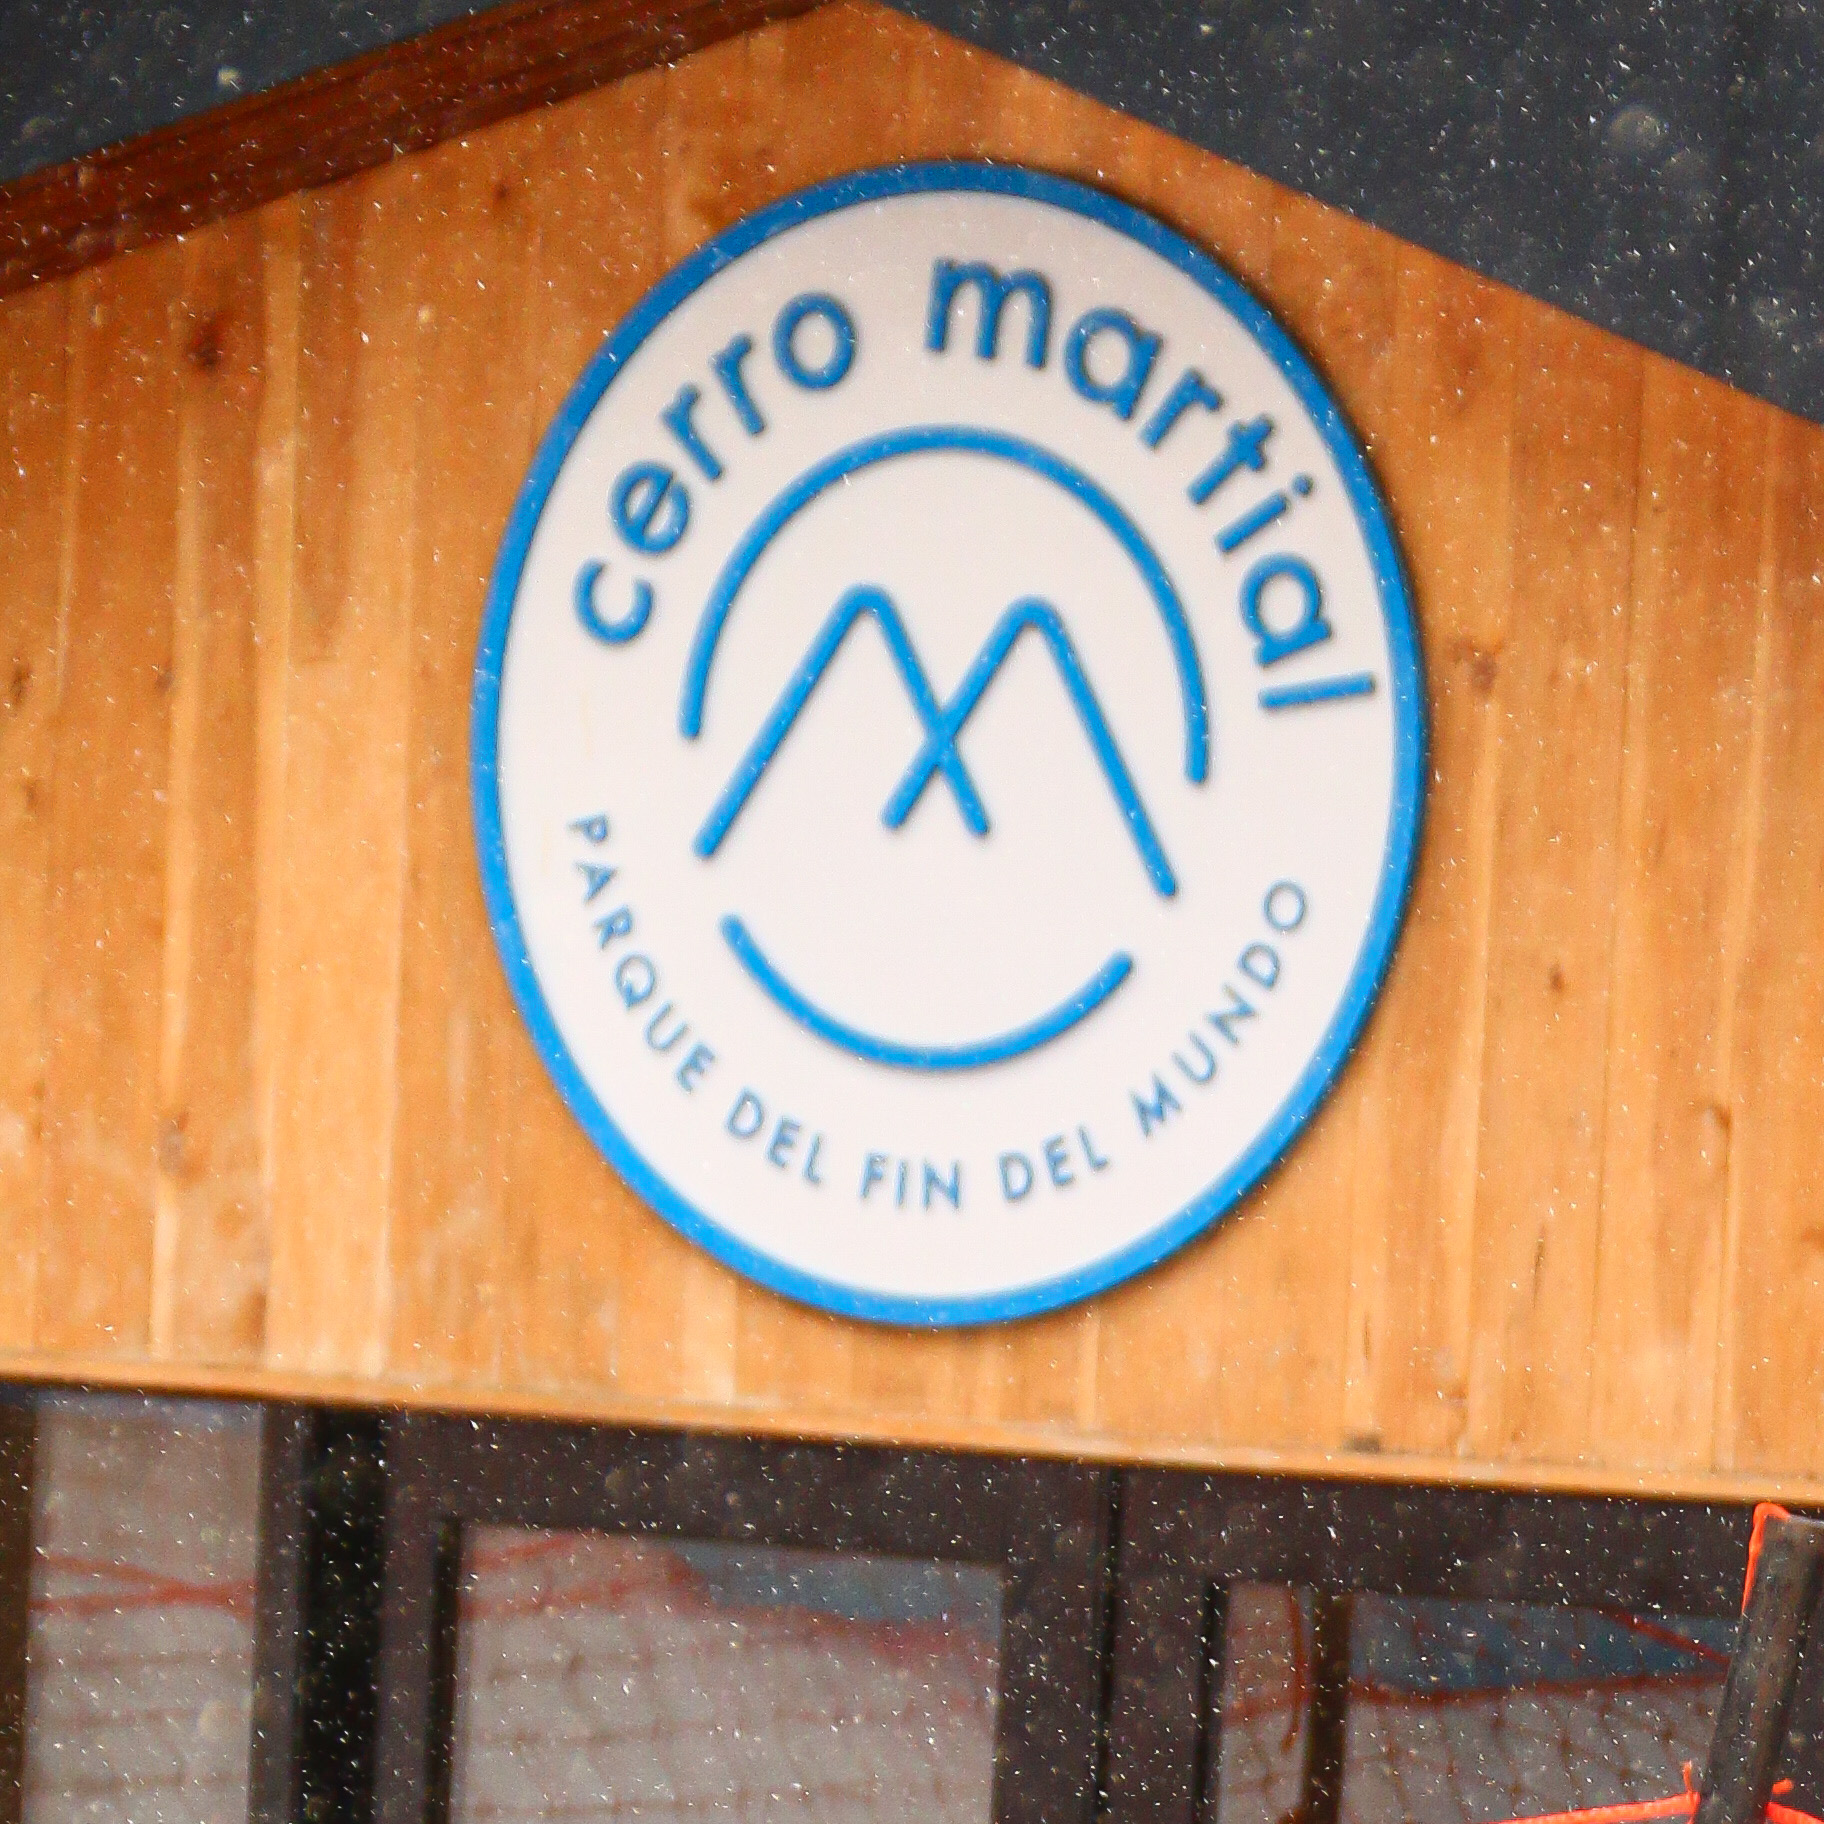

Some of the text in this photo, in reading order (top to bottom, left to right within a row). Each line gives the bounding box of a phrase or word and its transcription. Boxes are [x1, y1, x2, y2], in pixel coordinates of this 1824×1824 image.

[572, 256, 1376, 711] cerro martial
[568, 812, 1307, 1210] PARQUE DEL FIN DEL MUNDO
